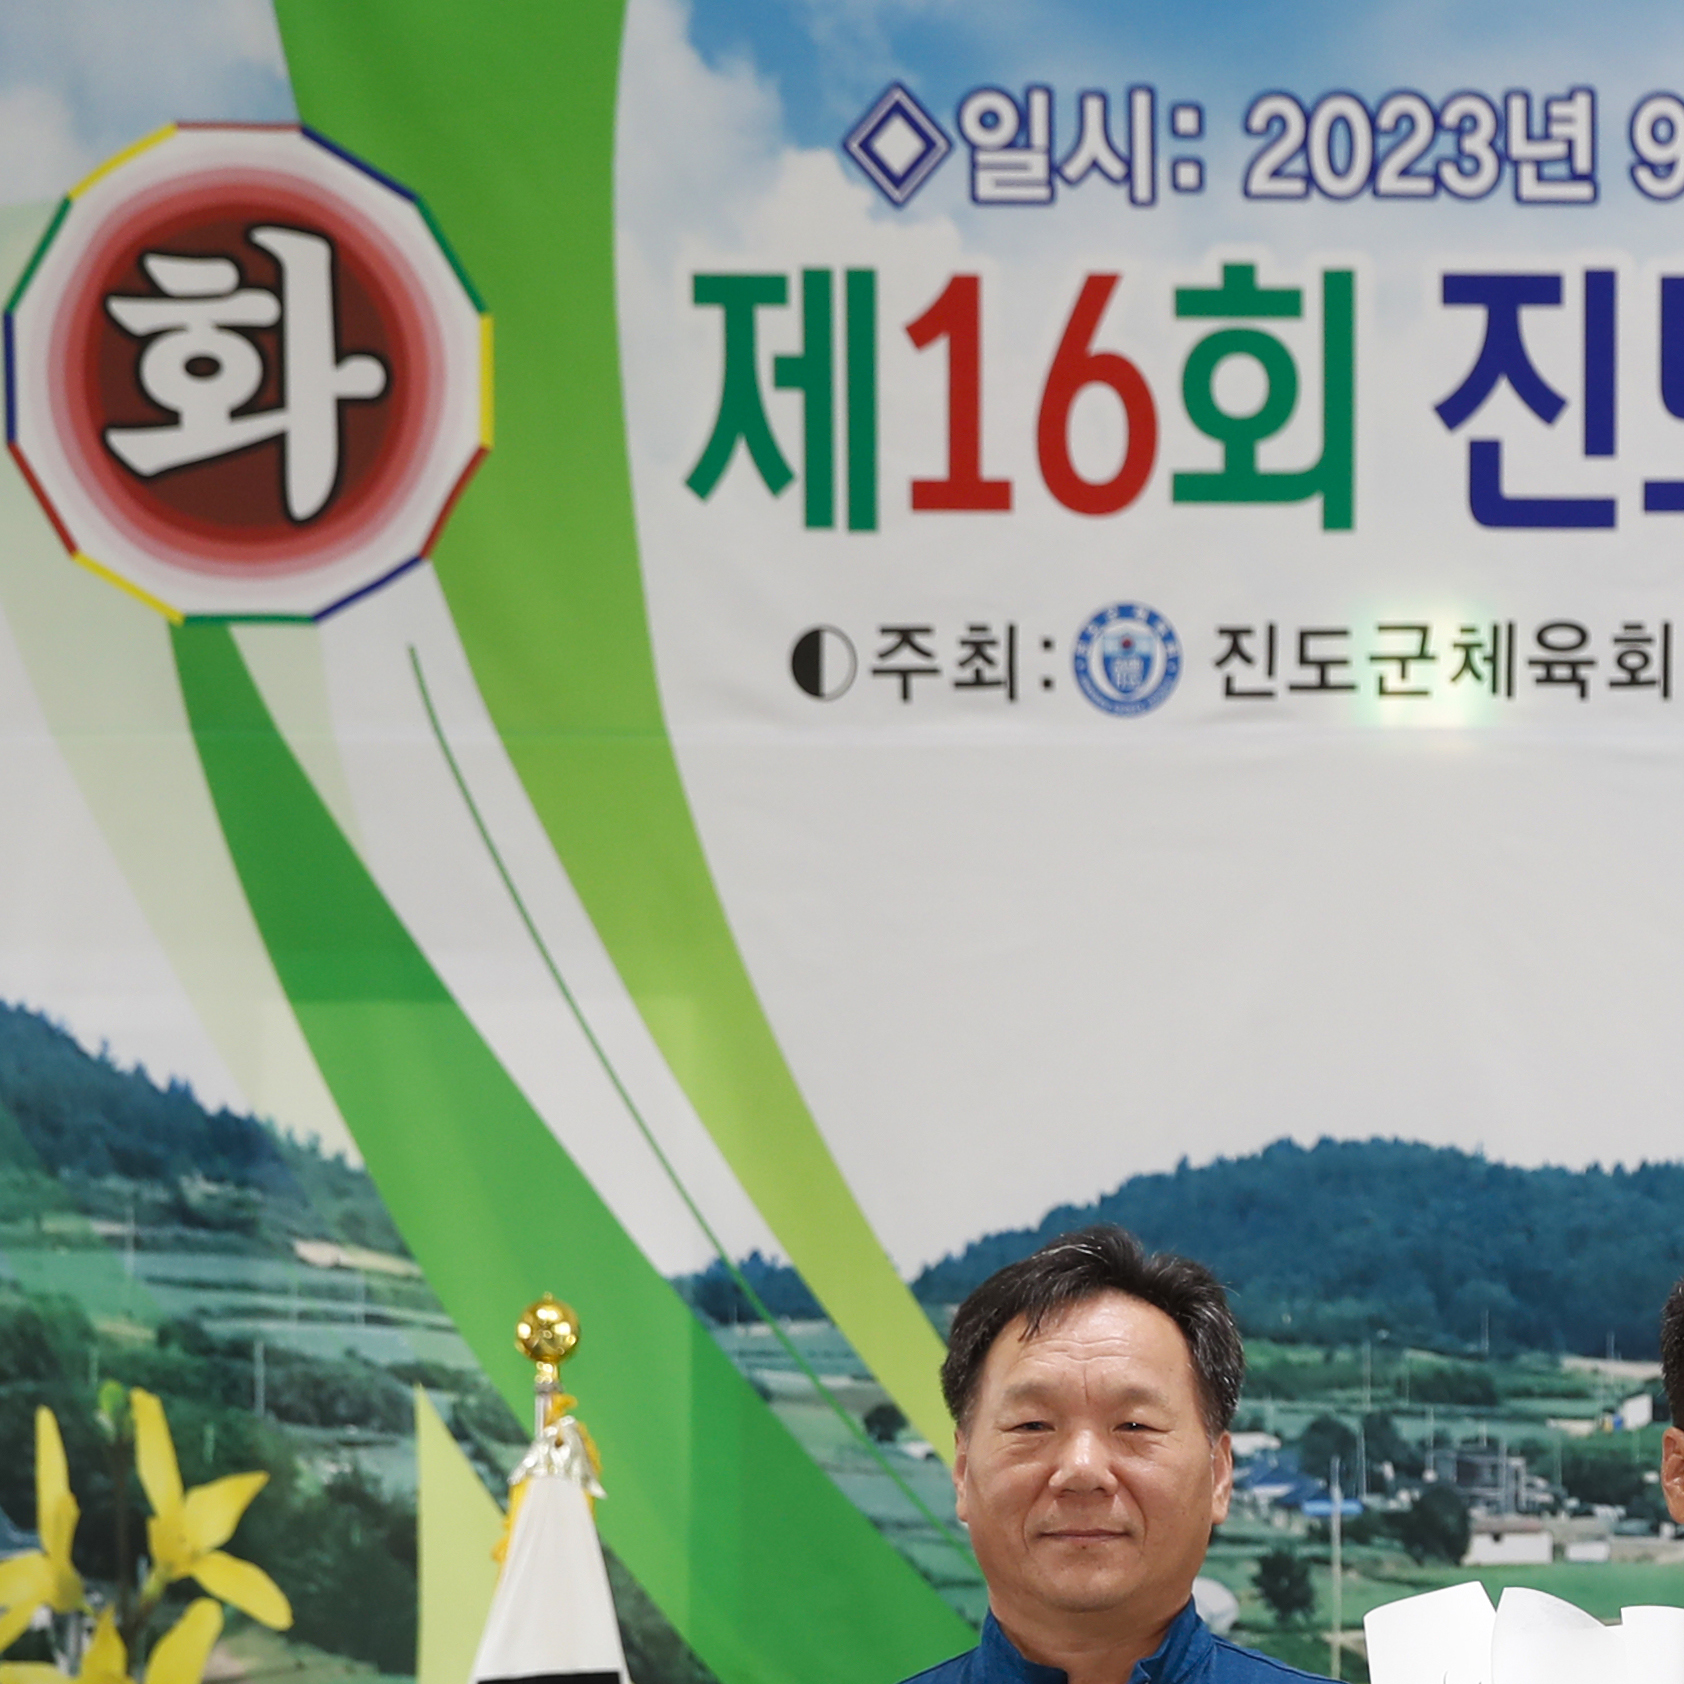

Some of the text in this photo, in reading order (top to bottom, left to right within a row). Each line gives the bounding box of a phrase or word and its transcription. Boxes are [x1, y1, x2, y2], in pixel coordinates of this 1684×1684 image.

[959, 85, 1203, 206] 일시:
[1245, 87, 1599, 203] 2023년
[103, 226, 388, 523] 화
[684, 262, 1357, 534] 제16회
[870, 622, 1057, 704] 주최:
[1212, 621, 1673, 700] 진도군체육회
